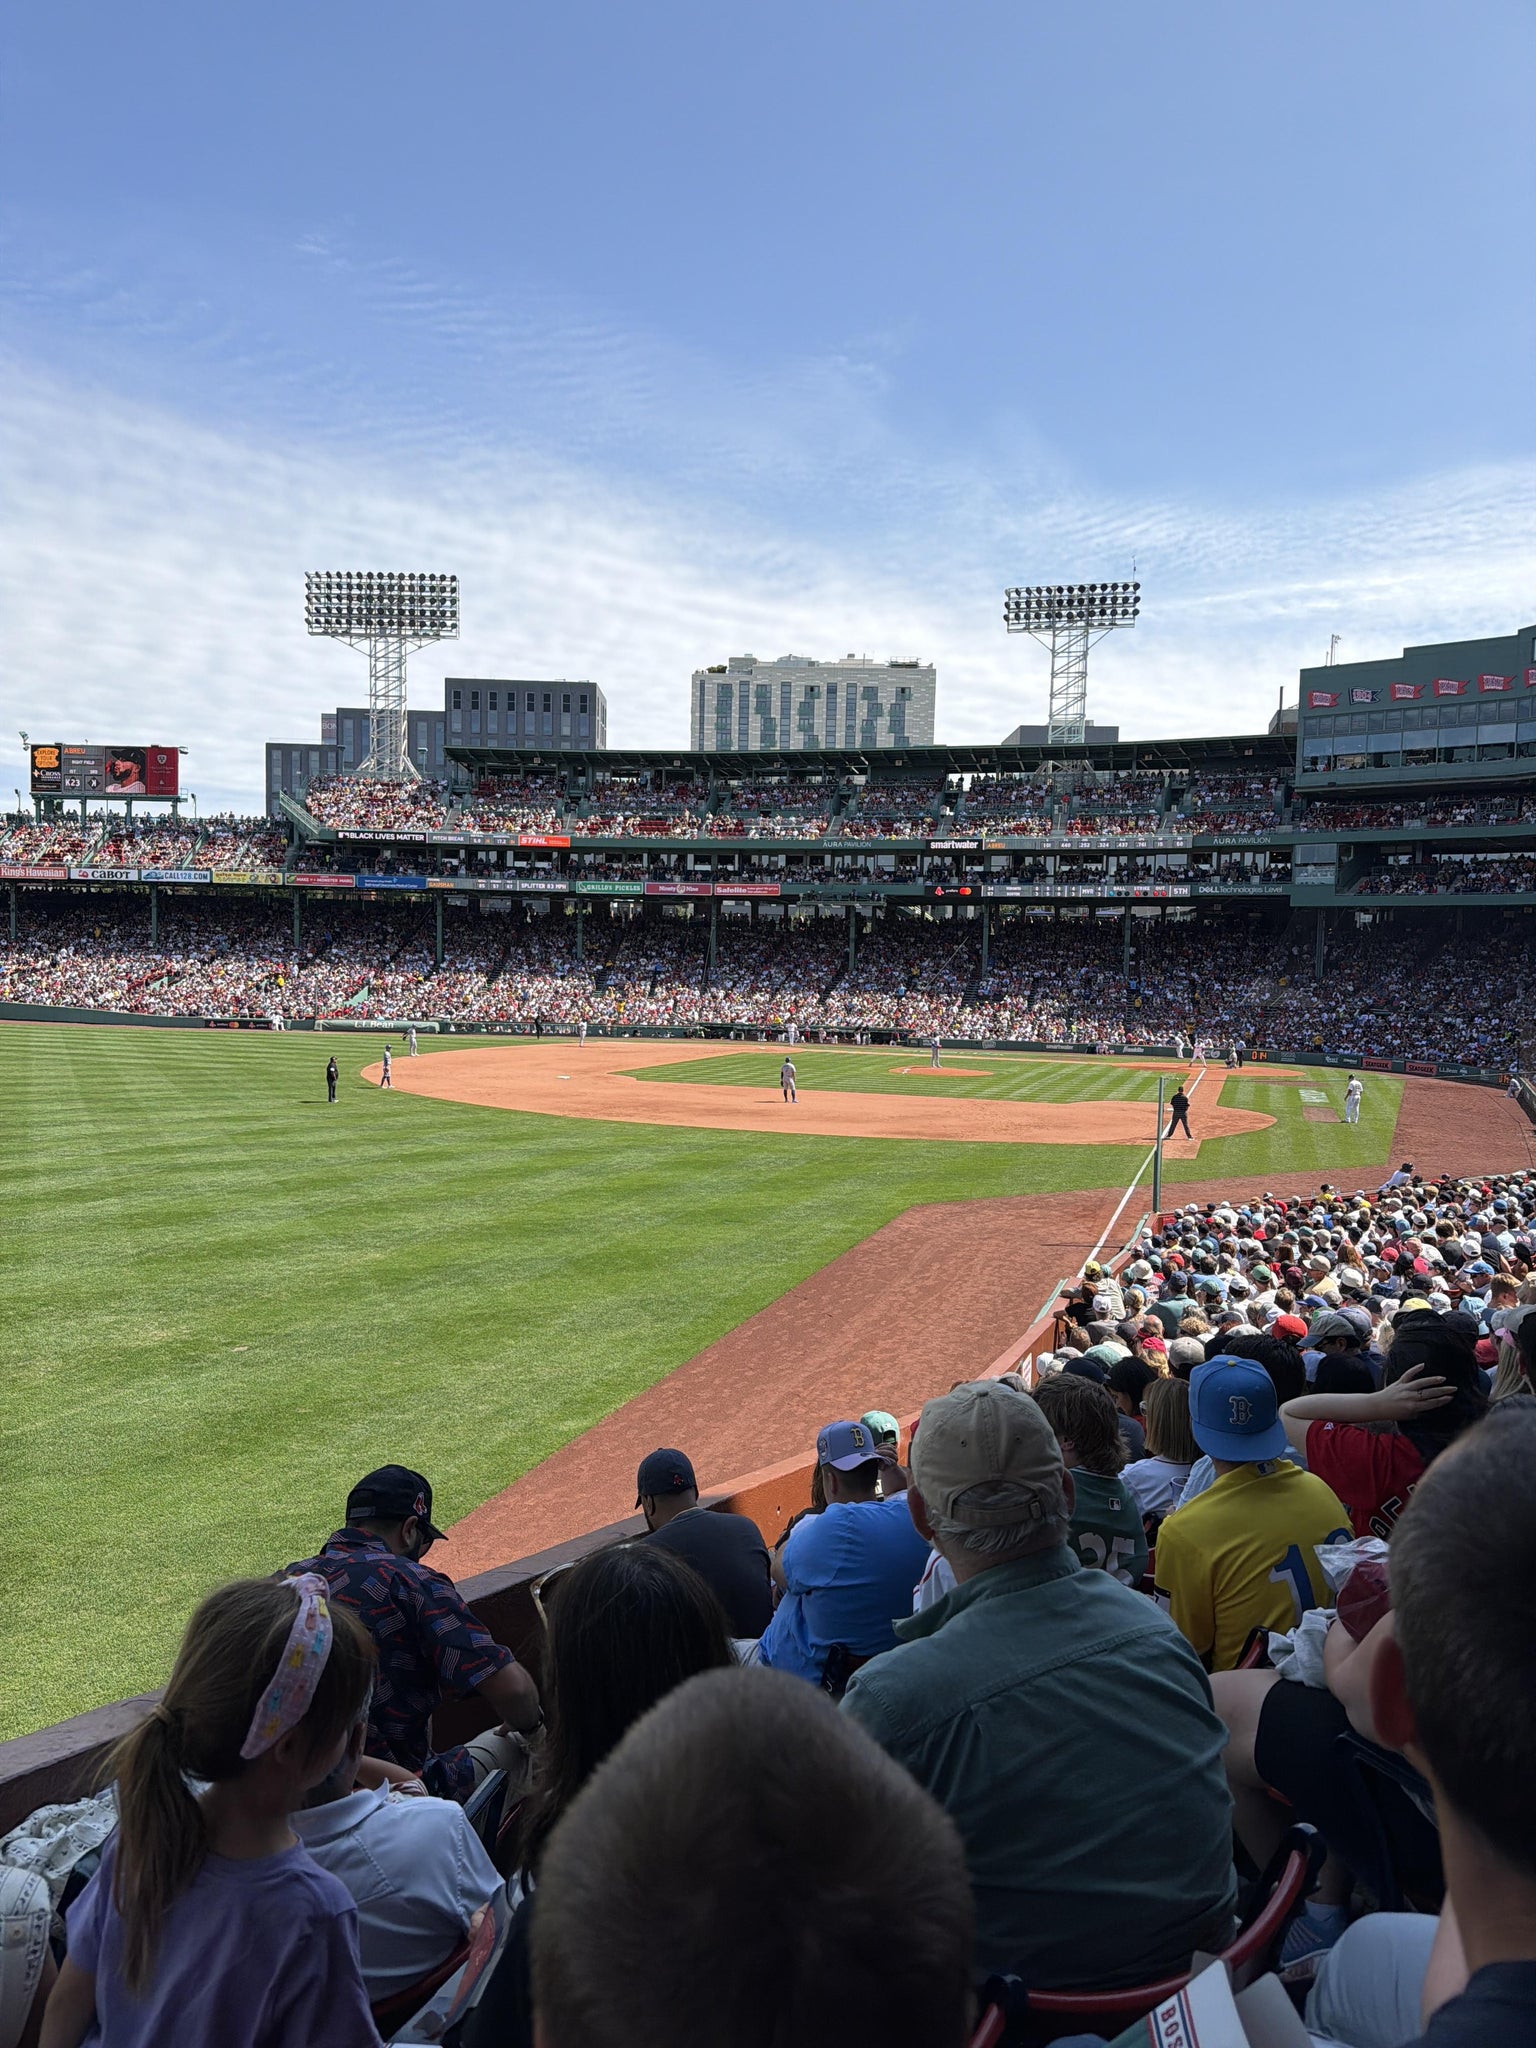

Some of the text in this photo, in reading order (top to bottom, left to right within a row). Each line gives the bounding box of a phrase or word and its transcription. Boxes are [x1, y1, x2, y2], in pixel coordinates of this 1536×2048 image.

[521, 836, 547, 844] STIHL
[930, 840, 979, 849] smartwater
[1, 867, 64, 877] King's Hawaiian
[165, 872, 208, 880] CALL128.COM
[1220, 886, 1263, 894] Technologies
[1365, 1060, 1389, 1069] SEATGEEK
[1408, 1064, 1434, 1074] SEATGEEK
[1228, 1395, 1253, 1425] B
[850, 1427, 865, 1448] B
